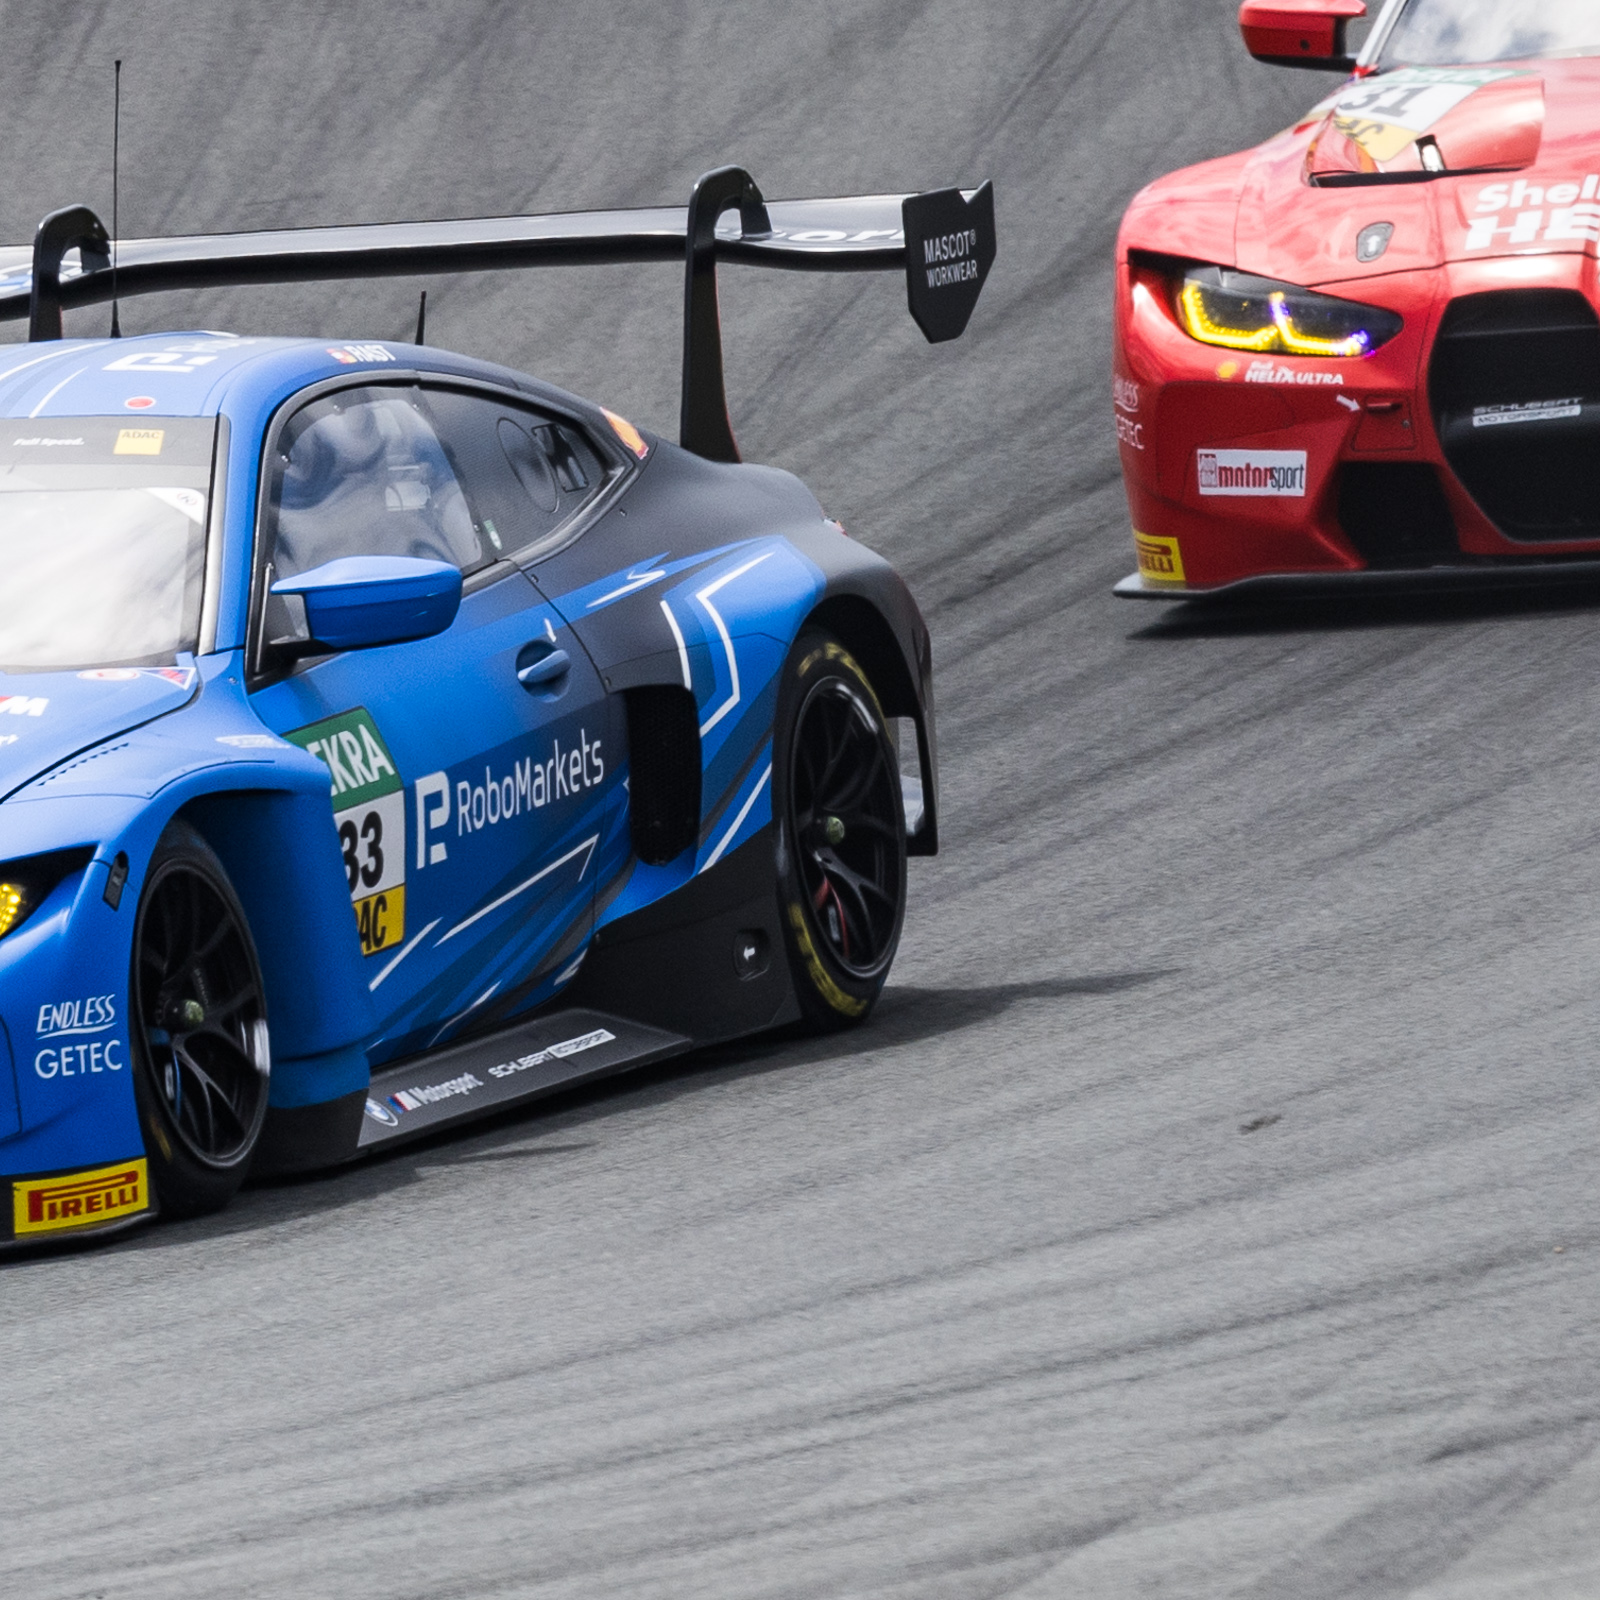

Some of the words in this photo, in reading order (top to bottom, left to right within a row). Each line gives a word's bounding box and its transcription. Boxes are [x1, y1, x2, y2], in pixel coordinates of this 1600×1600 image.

[1338, 84, 1432, 118] 31
[926, 259, 978, 289] WORKWEAR
[1295, 371, 1345, 386] ULTRA
[1472, 396, 1584, 415] SCHUBERT
[1475, 405, 1580, 426] MOTORSPORT
[13, 437, 40, 448] Full
[121, 430, 163, 442] ADAC
[1217, 462, 1305, 492] motorsport
[457, 727, 606, 837] RoboMarkets
[36, 994, 116, 1036] ENDLESS
[33, 1039, 123, 1080] GETEC
[26, 1169, 141, 1224] PIRELLI
